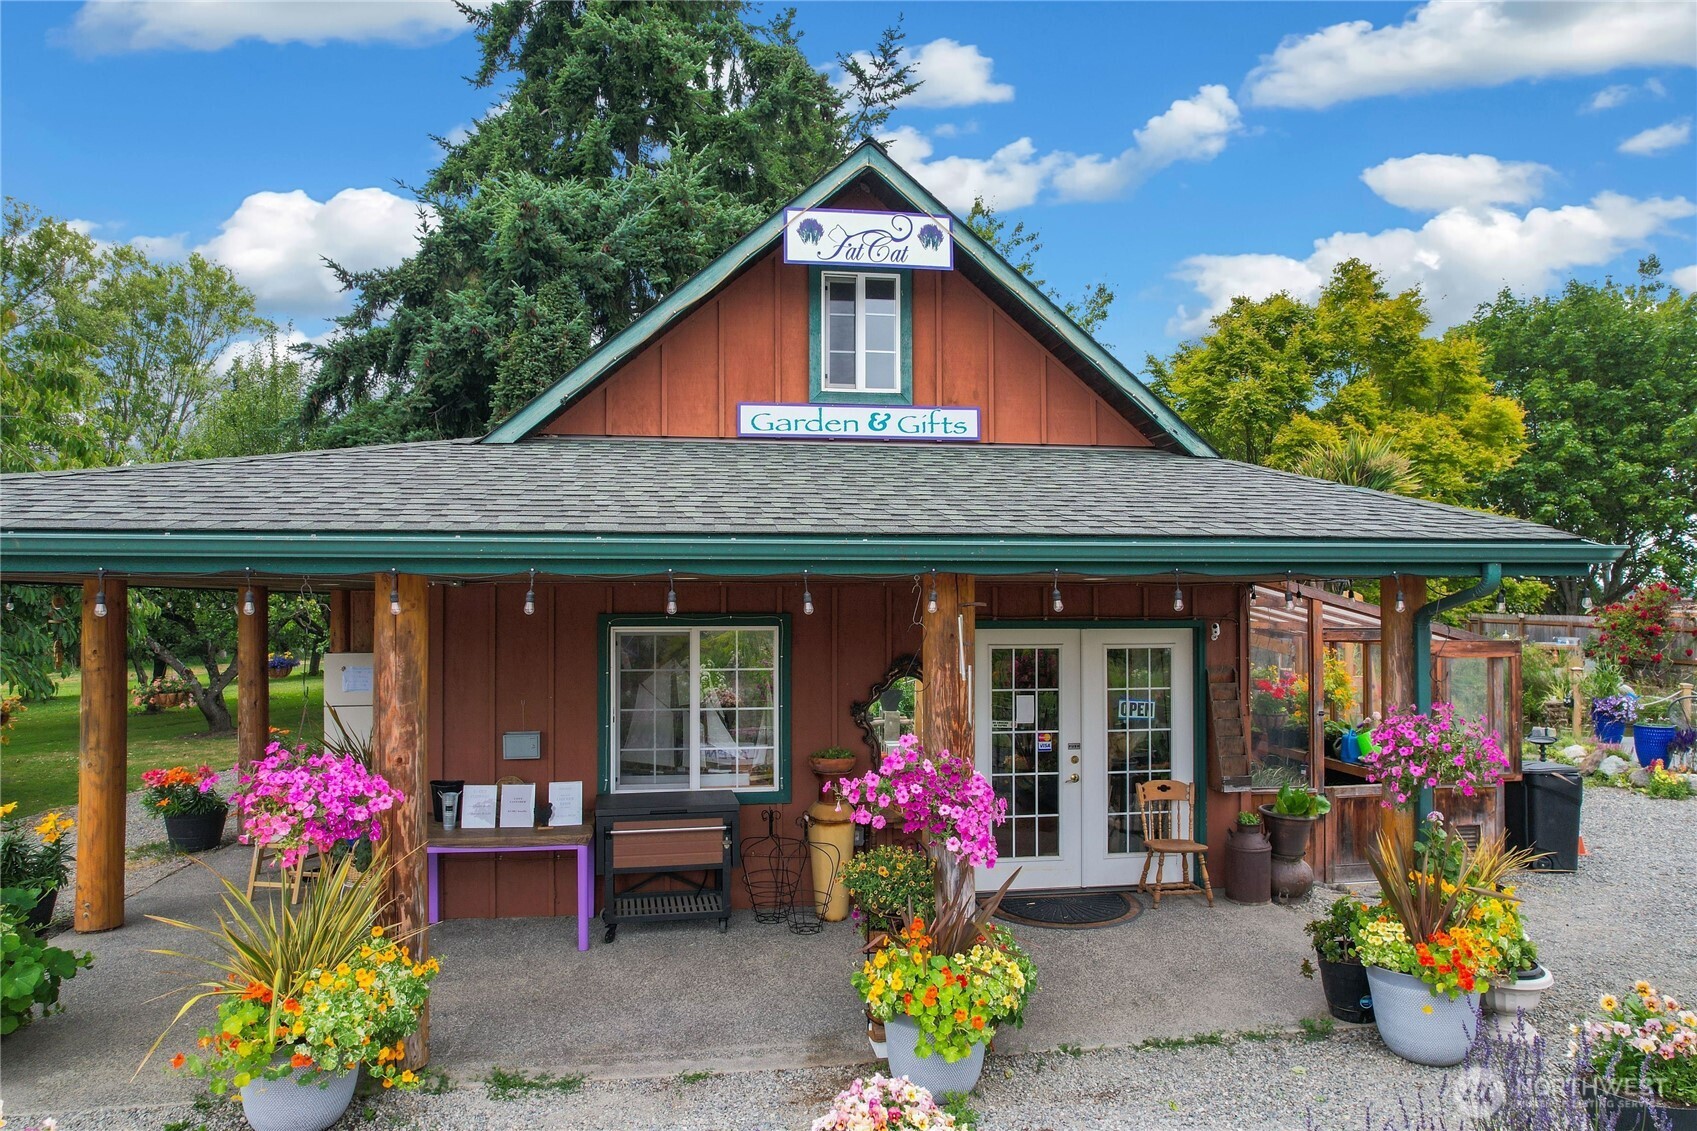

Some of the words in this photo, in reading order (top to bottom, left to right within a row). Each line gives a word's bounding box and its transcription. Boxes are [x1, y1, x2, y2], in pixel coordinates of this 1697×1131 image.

[817, 230, 864, 261] Fat
[862, 229, 909, 263] Cat
[750, 407, 859, 432] Garden
[867, 412, 891, 431] &
[897, 407, 968, 434] Gifts
[1120, 702, 1154, 717] OPEN
